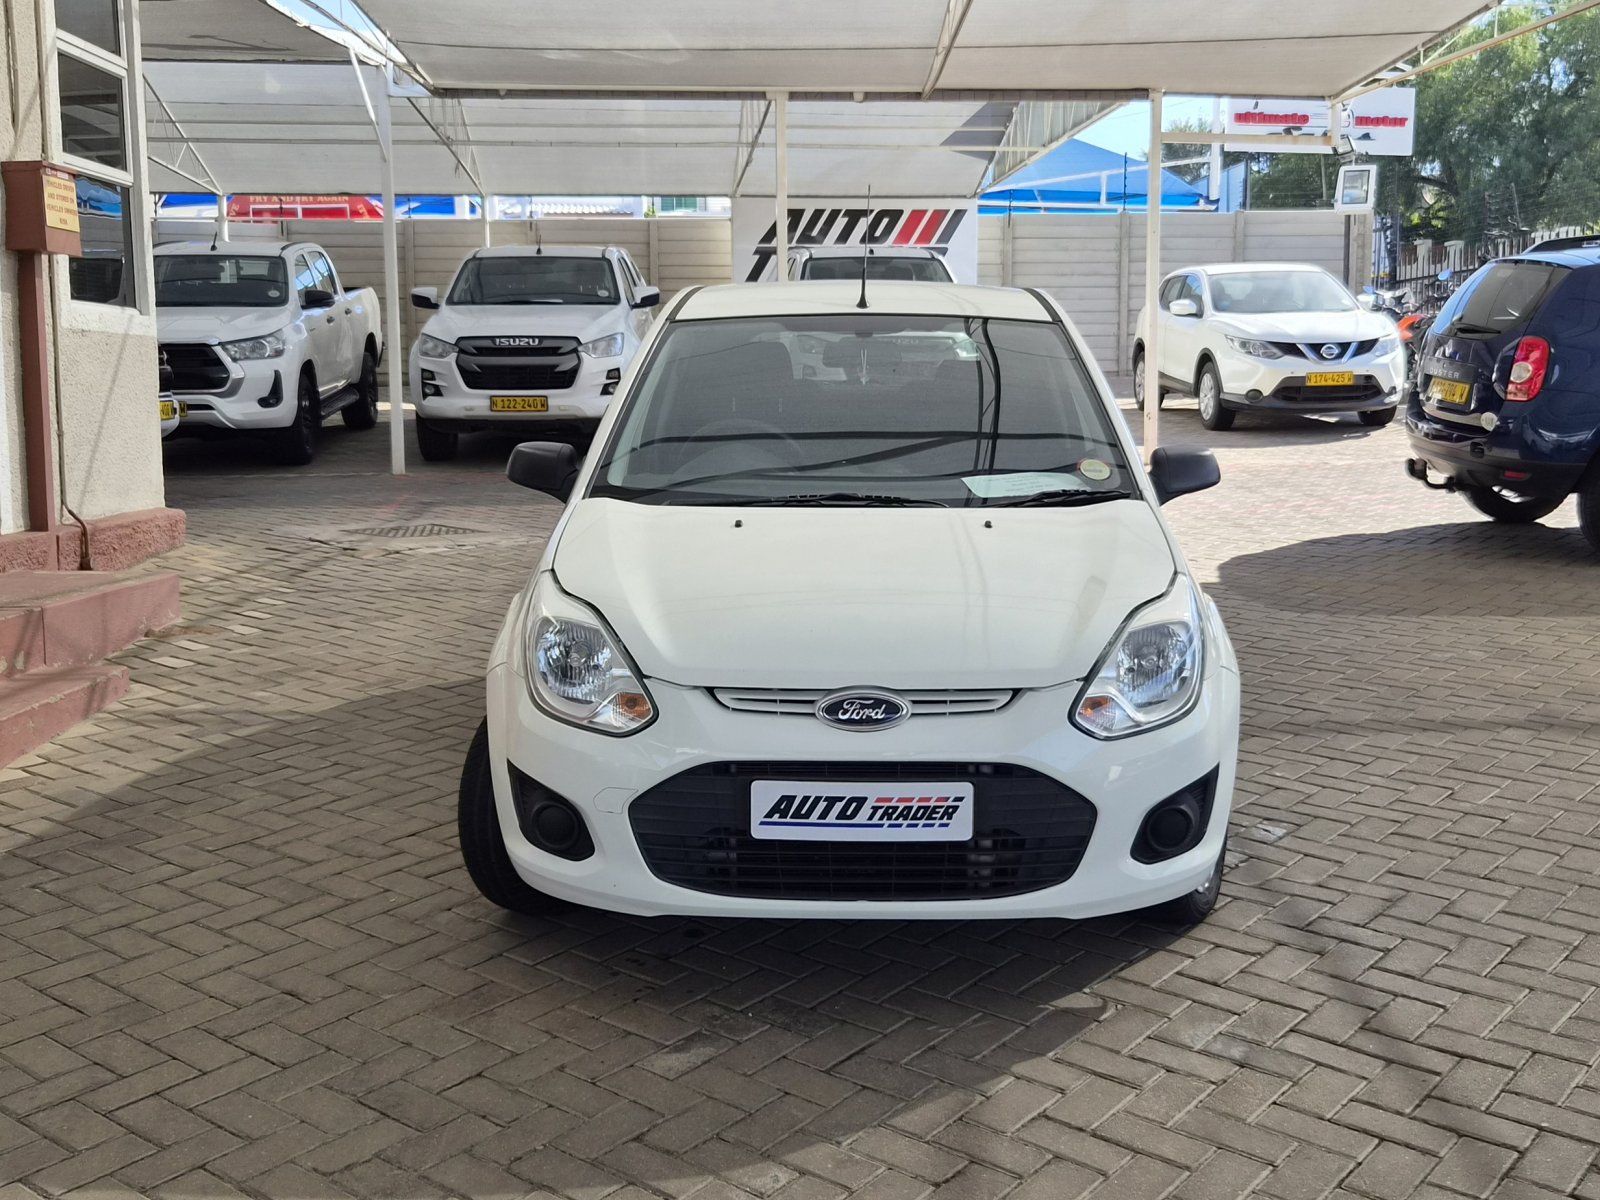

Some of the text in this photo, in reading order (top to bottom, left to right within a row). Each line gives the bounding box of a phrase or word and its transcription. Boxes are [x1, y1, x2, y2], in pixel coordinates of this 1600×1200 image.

[757, 208, 904, 245] AUTO
[495, 337, 540, 346] ISUZU
[1430, 367, 1460, 379] DUSTER
[492, 399, 498, 409] N
[500, 398, 539, 409] 122-240
[838, 699, 886, 720] Ford
[763, 795, 960, 822] AUTO TRADER
